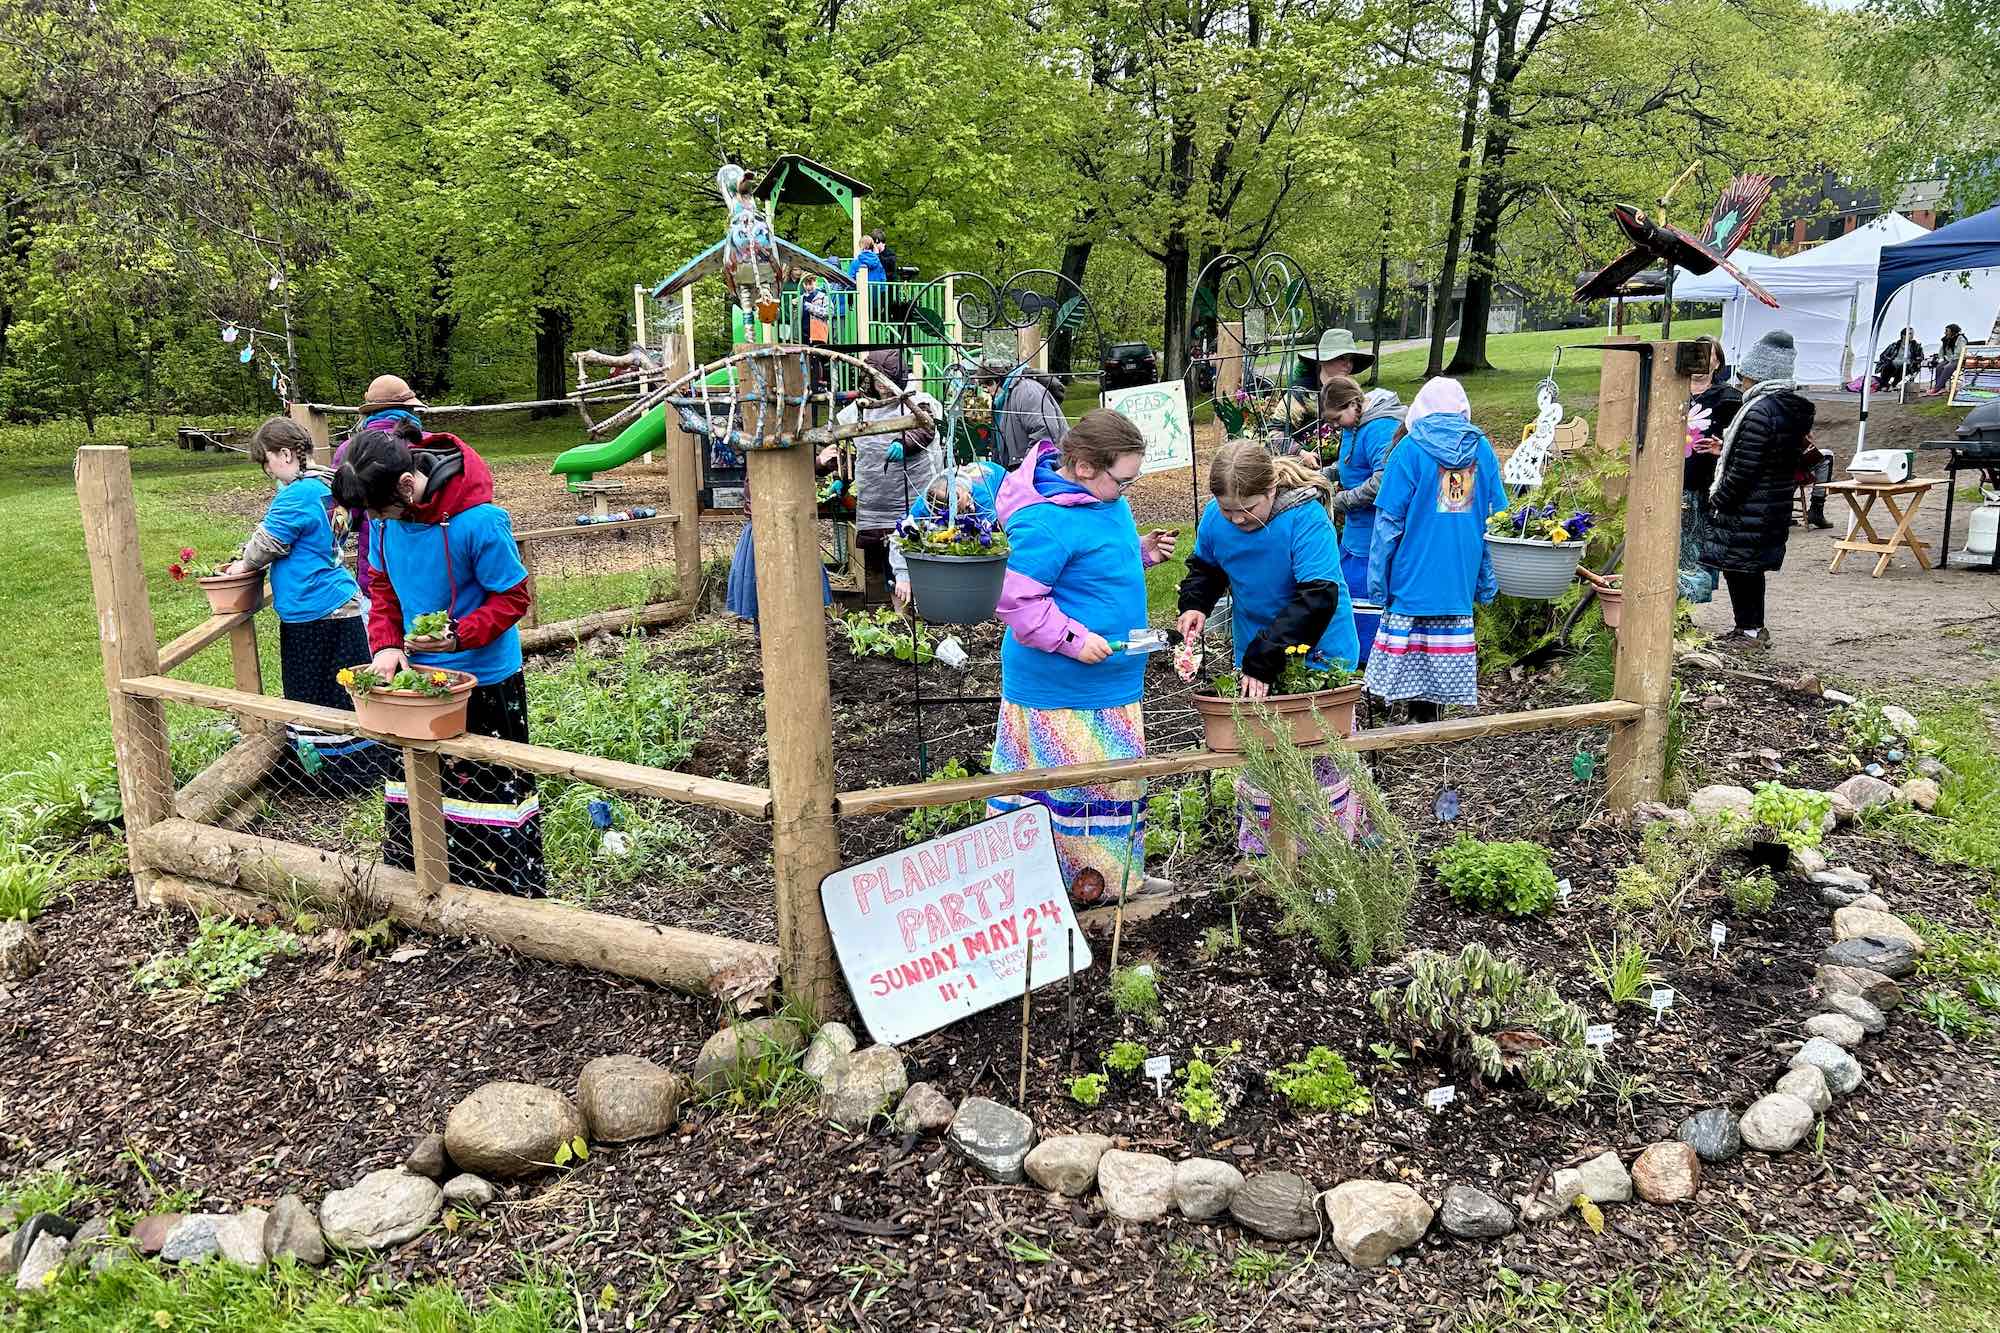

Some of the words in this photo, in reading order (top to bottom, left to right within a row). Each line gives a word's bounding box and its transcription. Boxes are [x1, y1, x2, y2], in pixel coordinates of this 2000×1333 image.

[1126, 395, 1161, 413] PEAS
[853, 812, 1040, 914] PLANTING
[897, 868, 1016, 953] PARTY
[869, 943, 959, 997] SUNDAY
[962, 915, 1020, 962] MAY
[1023, 899, 1063, 939] 24
[991, 938, 1048, 970] EVERYNE
[995, 951, 1048, 980] WELCME
[937, 973, 978, 1003] 11-1
